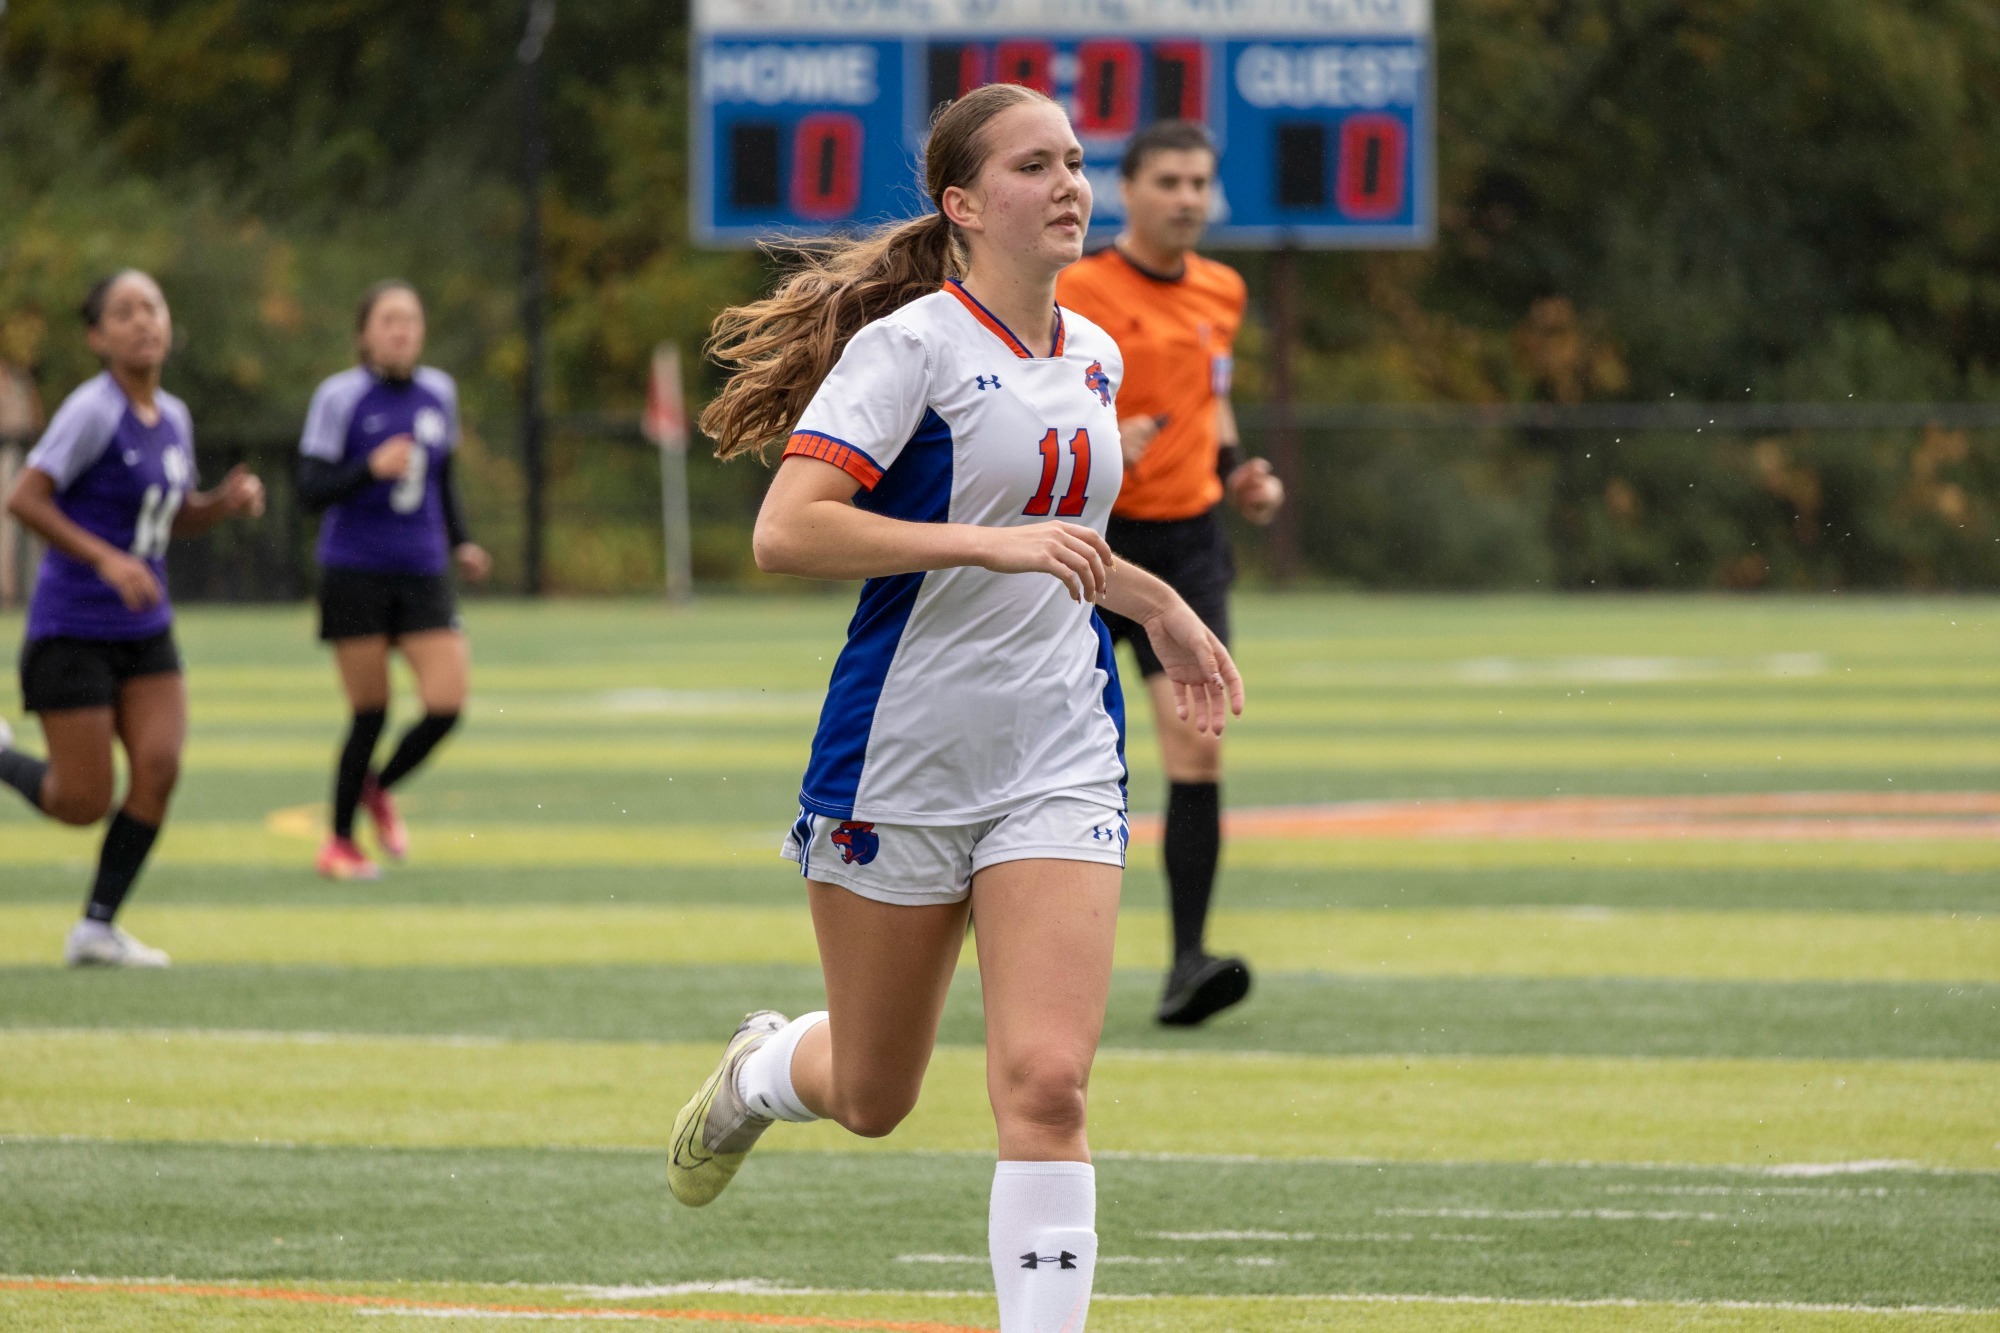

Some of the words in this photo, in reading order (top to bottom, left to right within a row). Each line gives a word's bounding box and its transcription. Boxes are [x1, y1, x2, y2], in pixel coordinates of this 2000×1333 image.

[704, 46, 879, 104] HOME
[1236, 46, 1420, 107] GUEST
[793, 115, 863, 218] 0
[1337, 114, 1405, 217] 0
[1021, 427, 1091, 517] 11
